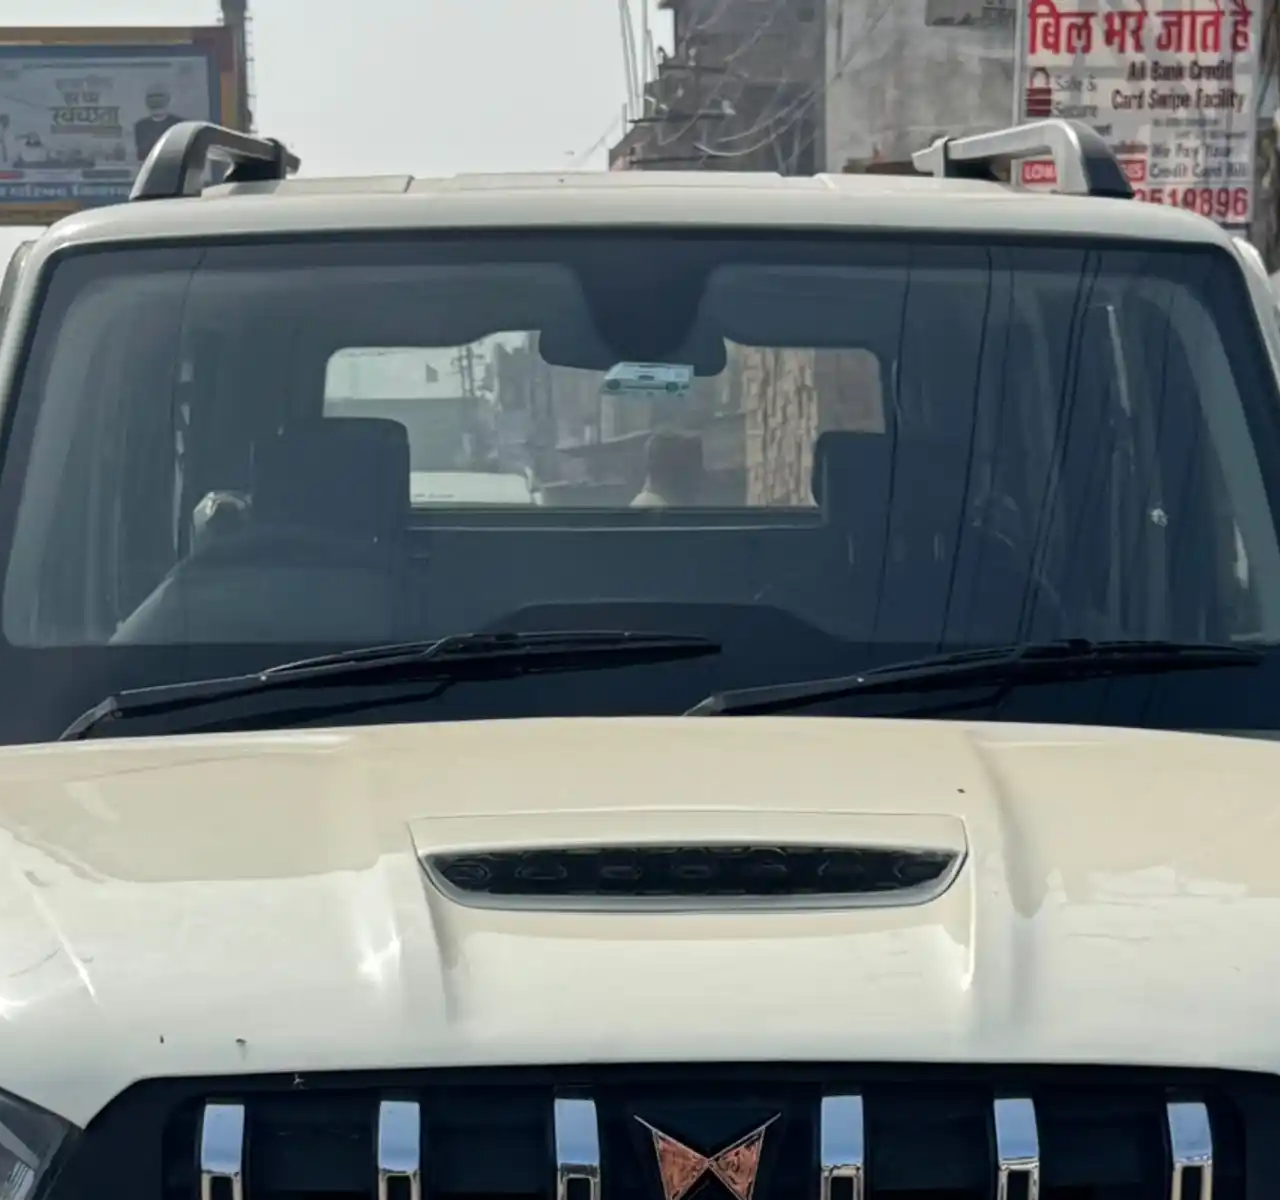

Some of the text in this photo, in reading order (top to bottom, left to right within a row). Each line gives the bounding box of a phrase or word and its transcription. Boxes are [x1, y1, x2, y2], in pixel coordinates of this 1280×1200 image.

[1027, 0, 1098, 54] बिल
[1150, 60, 1184, 81] Bank
[1189, 60, 1234, 81] Credit
[1111, 87, 1245, 113] Card Swipe Facility
